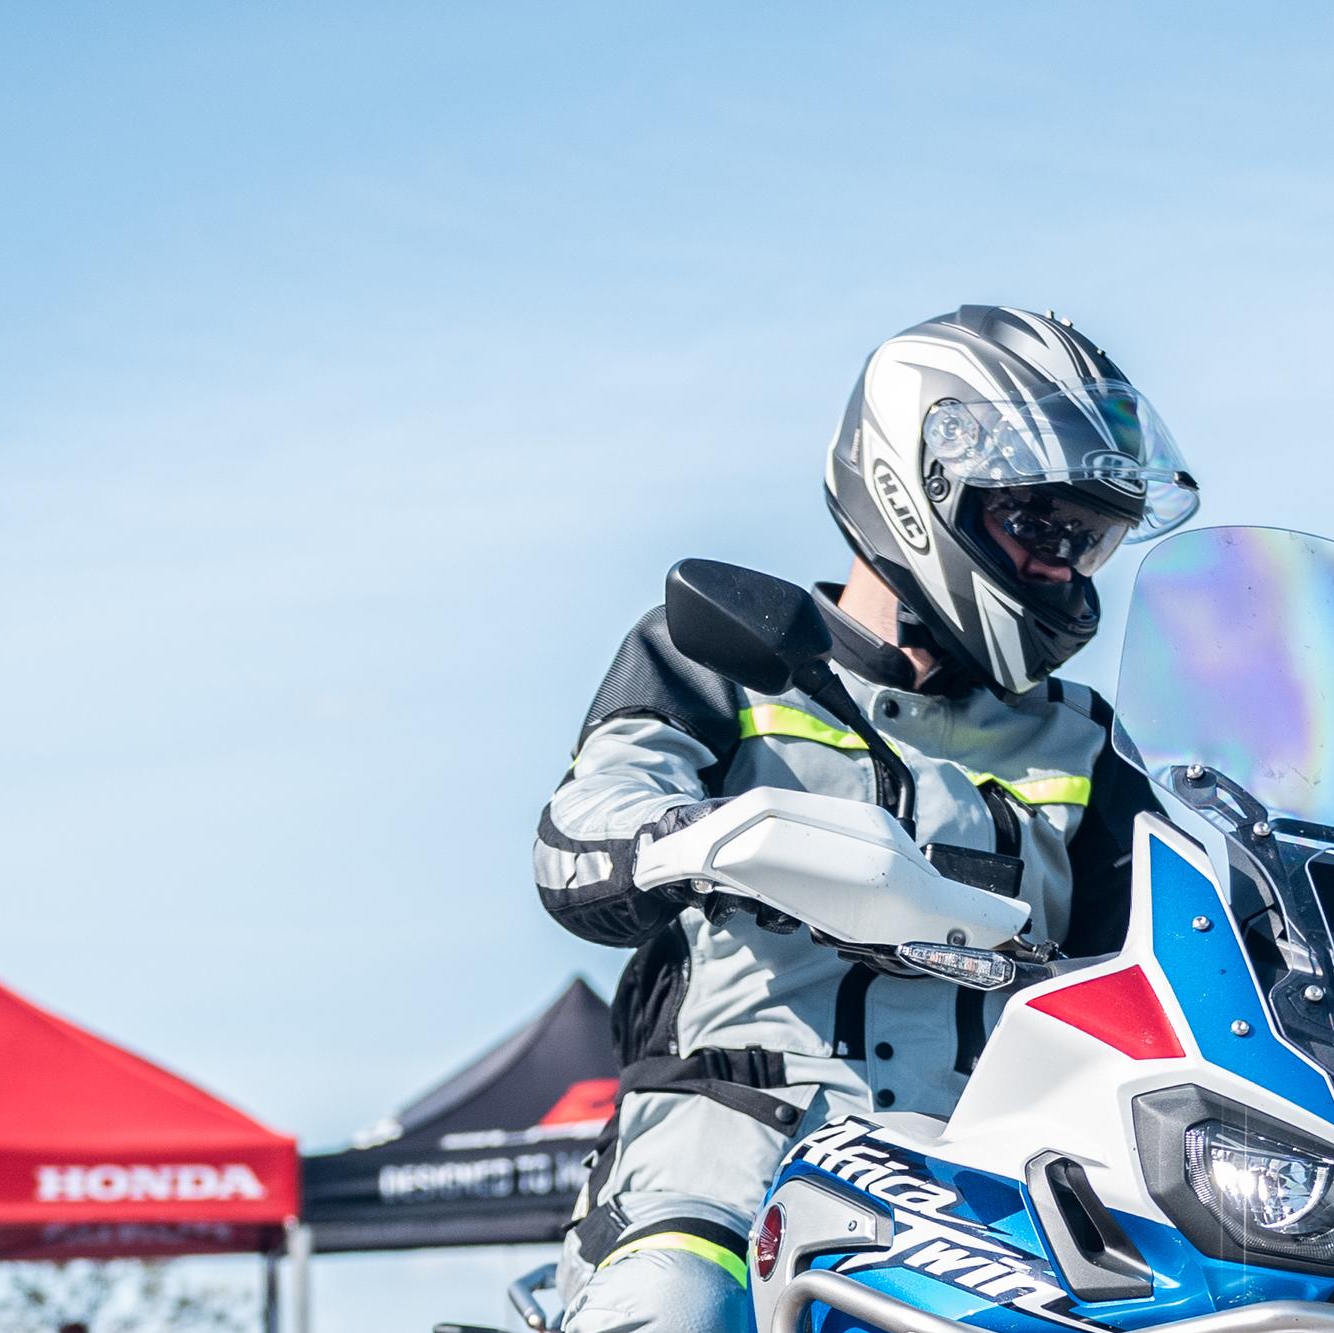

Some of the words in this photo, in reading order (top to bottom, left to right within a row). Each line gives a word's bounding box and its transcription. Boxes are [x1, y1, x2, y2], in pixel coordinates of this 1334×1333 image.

[878, 473, 924, 539] HJC
[34, 1163, 267, 1202] HONDA
[784, 1117, 987, 1230] Africa
